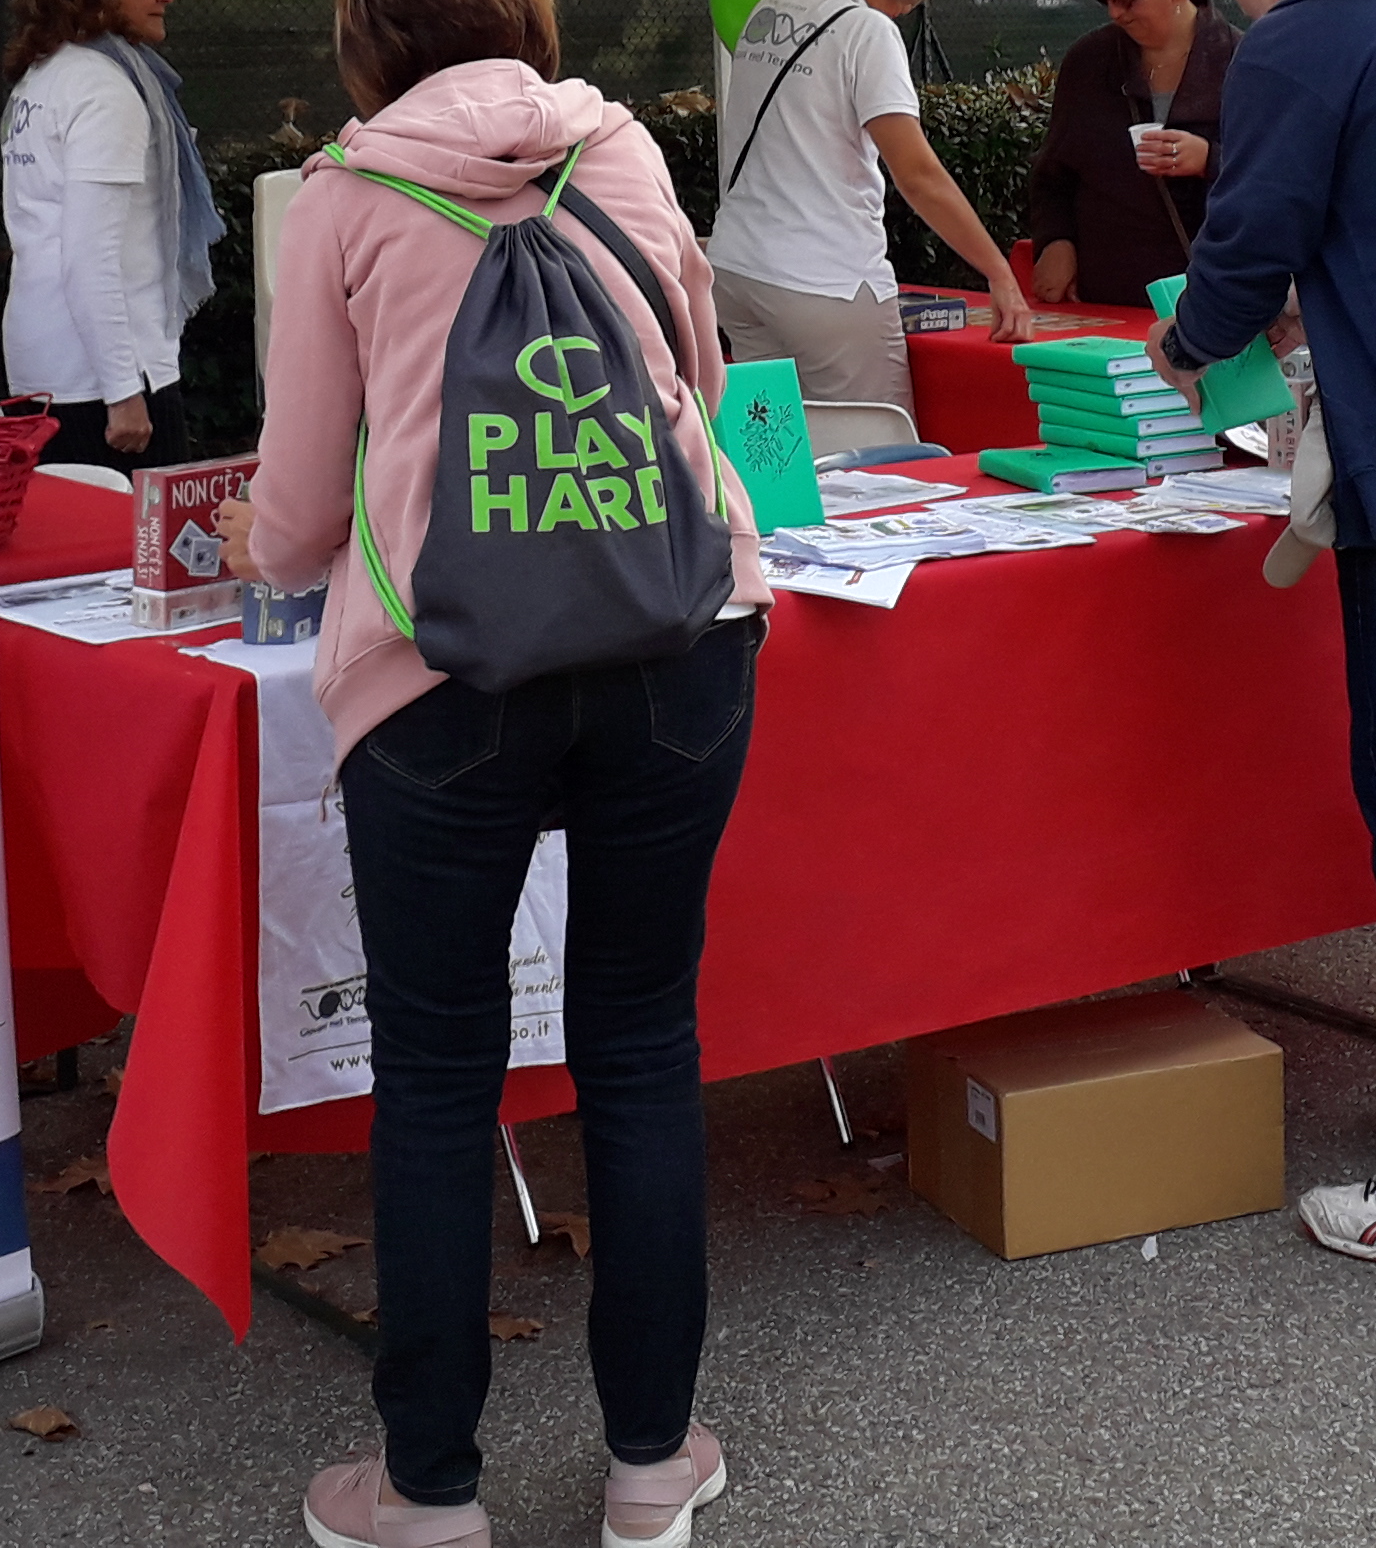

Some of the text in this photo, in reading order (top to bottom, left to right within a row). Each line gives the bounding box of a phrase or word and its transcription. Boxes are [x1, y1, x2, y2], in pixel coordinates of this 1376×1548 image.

[468, 405, 657, 476] PLAY
[172, 476, 207, 509] NON
[470, 465, 667, 533] HARD
[509, 946, 548, 972] genda
[346, 1015, 372, 1025] Temp
